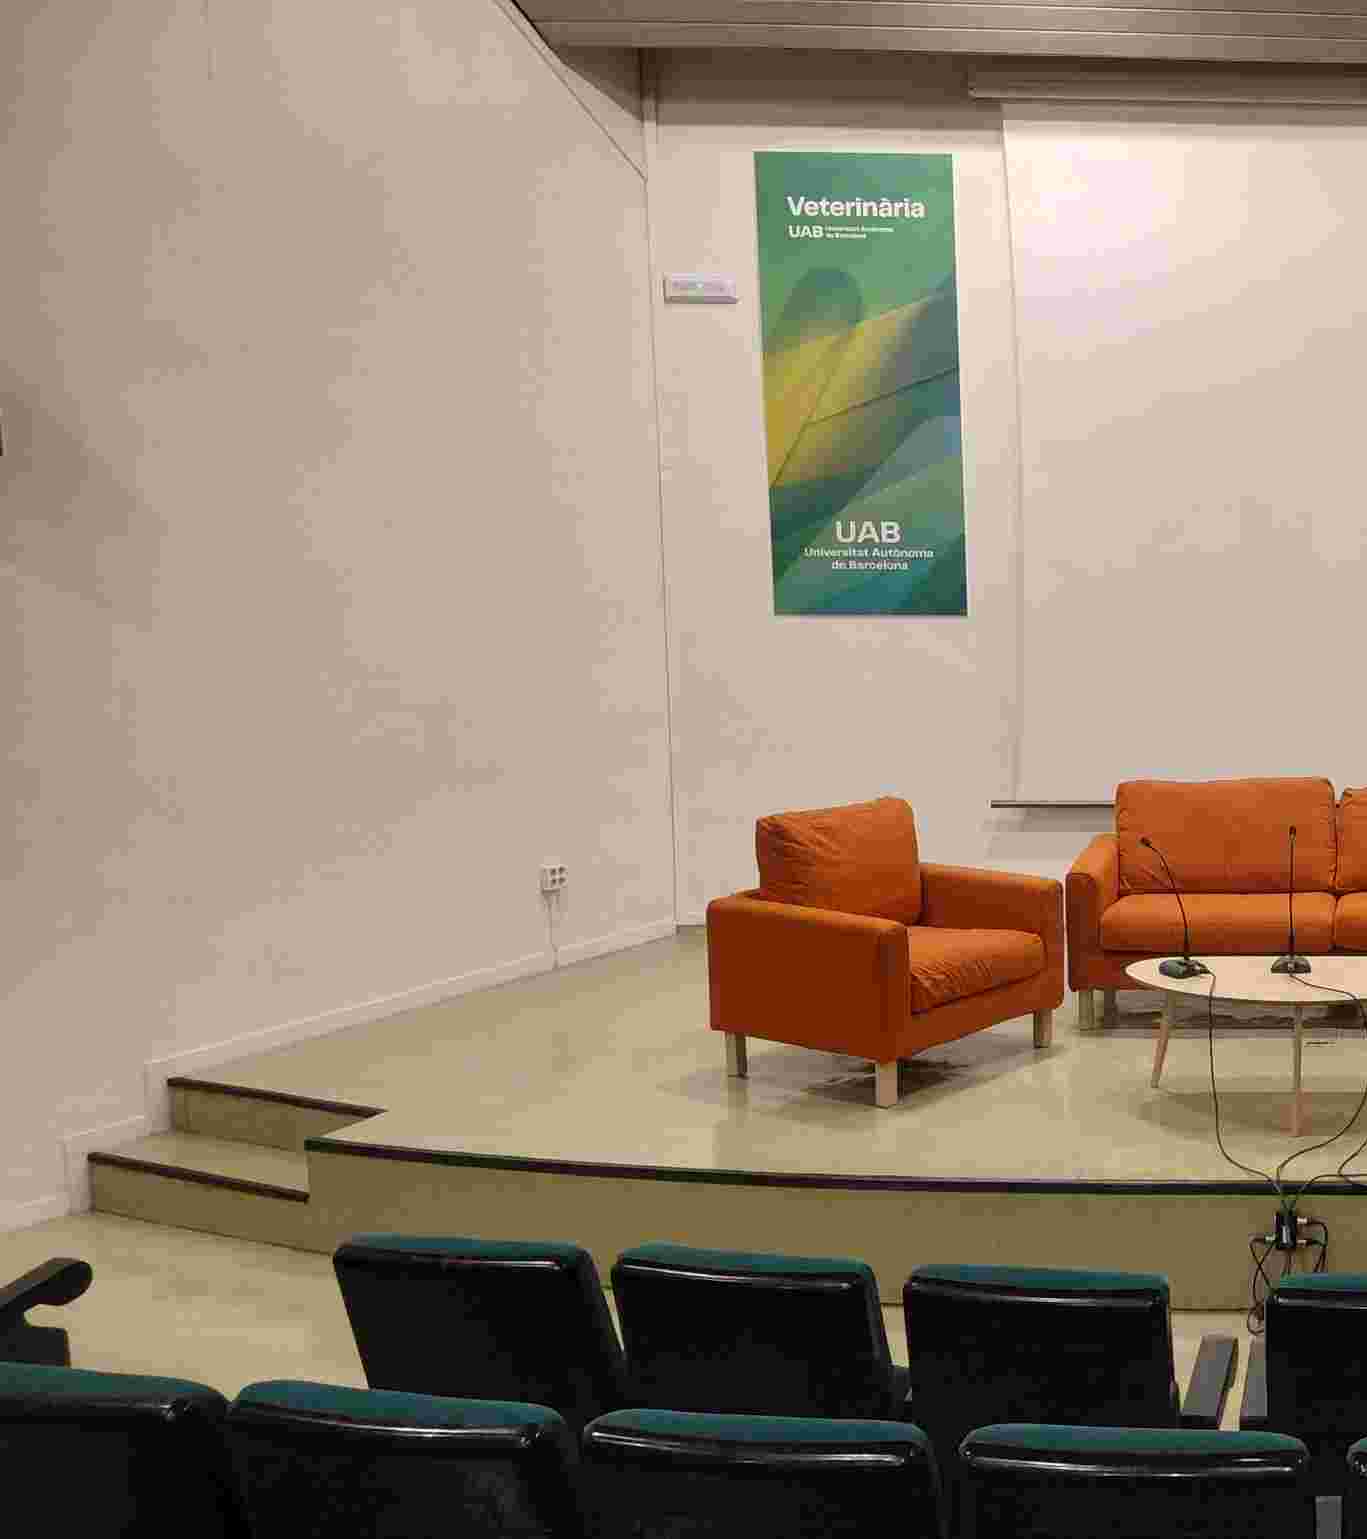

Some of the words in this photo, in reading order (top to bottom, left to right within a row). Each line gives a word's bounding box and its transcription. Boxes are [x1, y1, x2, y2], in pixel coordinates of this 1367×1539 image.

[786, 195, 926, 218] Veterinària
[788, 225, 825, 239] UAB
[835, 520, 902, 544] UAB
[804, 547, 869, 558] Universitat
[831, 559, 848, 571] de
[849, 559, 910, 571] Barcelona
